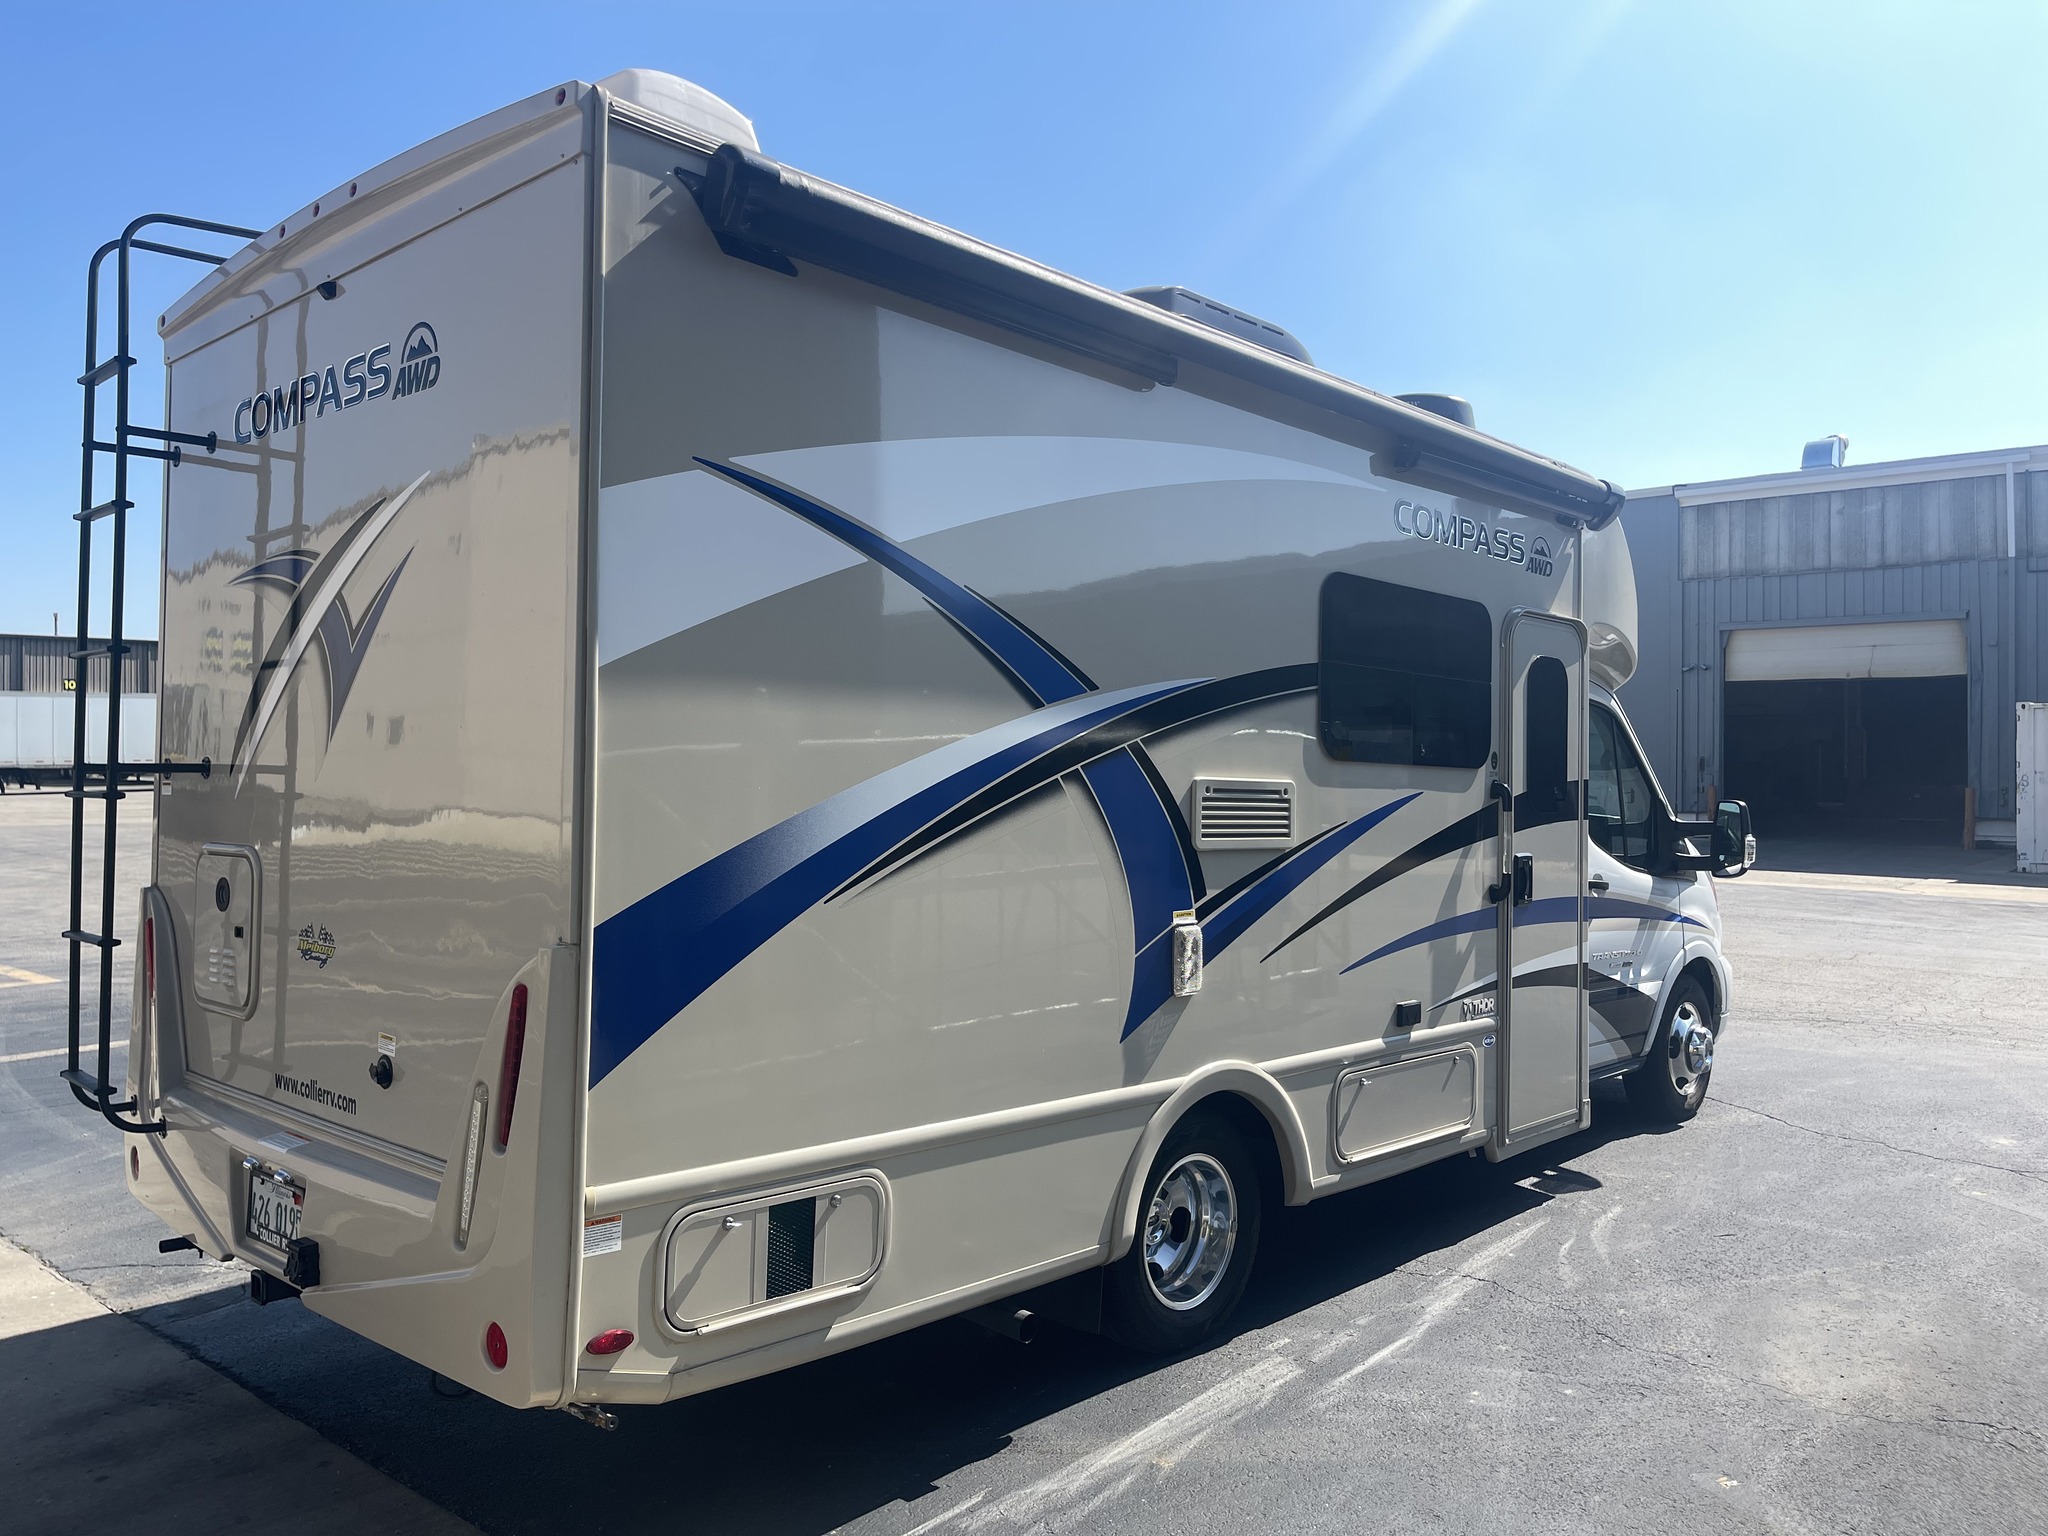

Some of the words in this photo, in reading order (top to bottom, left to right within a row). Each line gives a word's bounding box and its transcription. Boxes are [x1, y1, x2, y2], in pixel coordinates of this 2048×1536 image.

[233, 342, 392, 445] COMPASS
[392, 355, 441, 400] AWD
[1394, 498, 1526, 565] COMPASS
[1525, 556, 1553, 577] AWD
[1472, 998, 1495, 1015] THOR
[275, 1073, 357, 1115] www.collierrv.com
[260, 1228, 281, 1248] COLLIER
